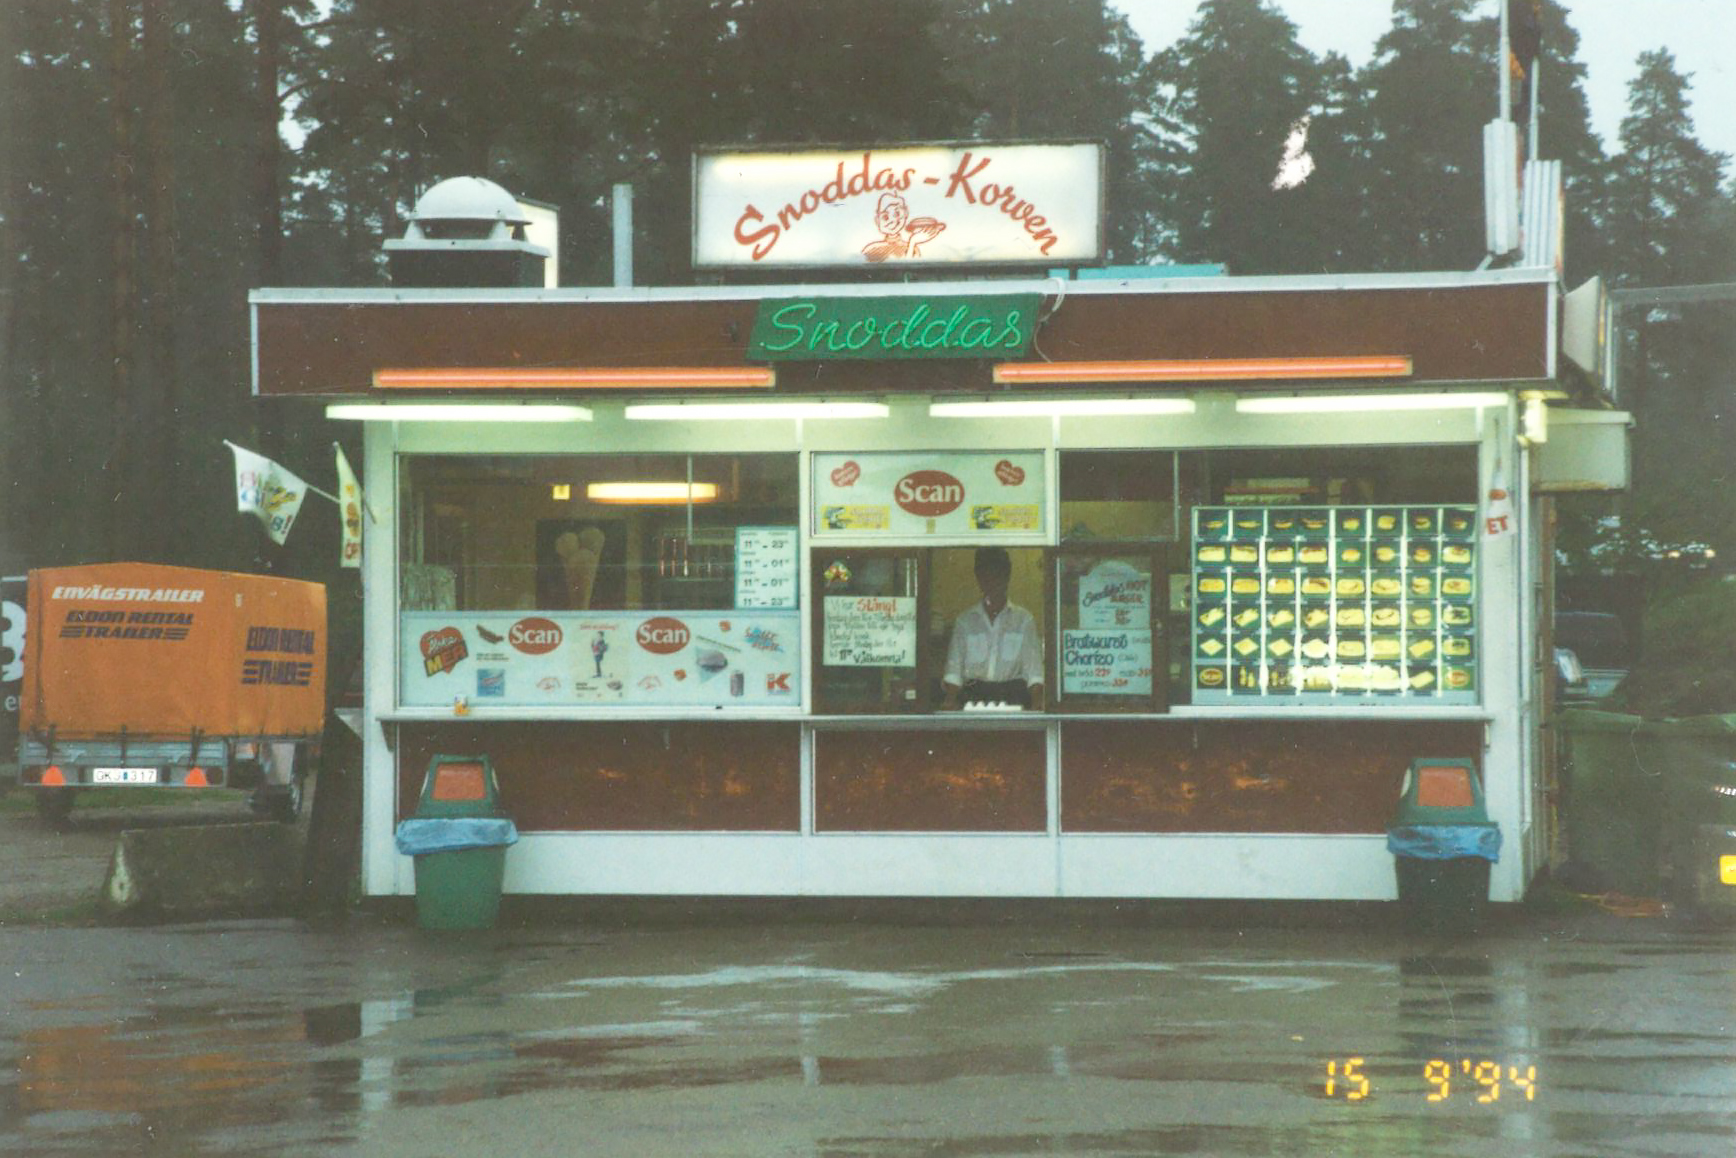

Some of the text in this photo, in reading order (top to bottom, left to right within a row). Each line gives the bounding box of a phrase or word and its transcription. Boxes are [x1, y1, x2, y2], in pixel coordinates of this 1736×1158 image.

[761, 303, 1023, 352] Snoddas
[899, 478, 961, 503] Scan
[511, 624, 560, 645] Scan
[639, 624, 688, 644] Scan
